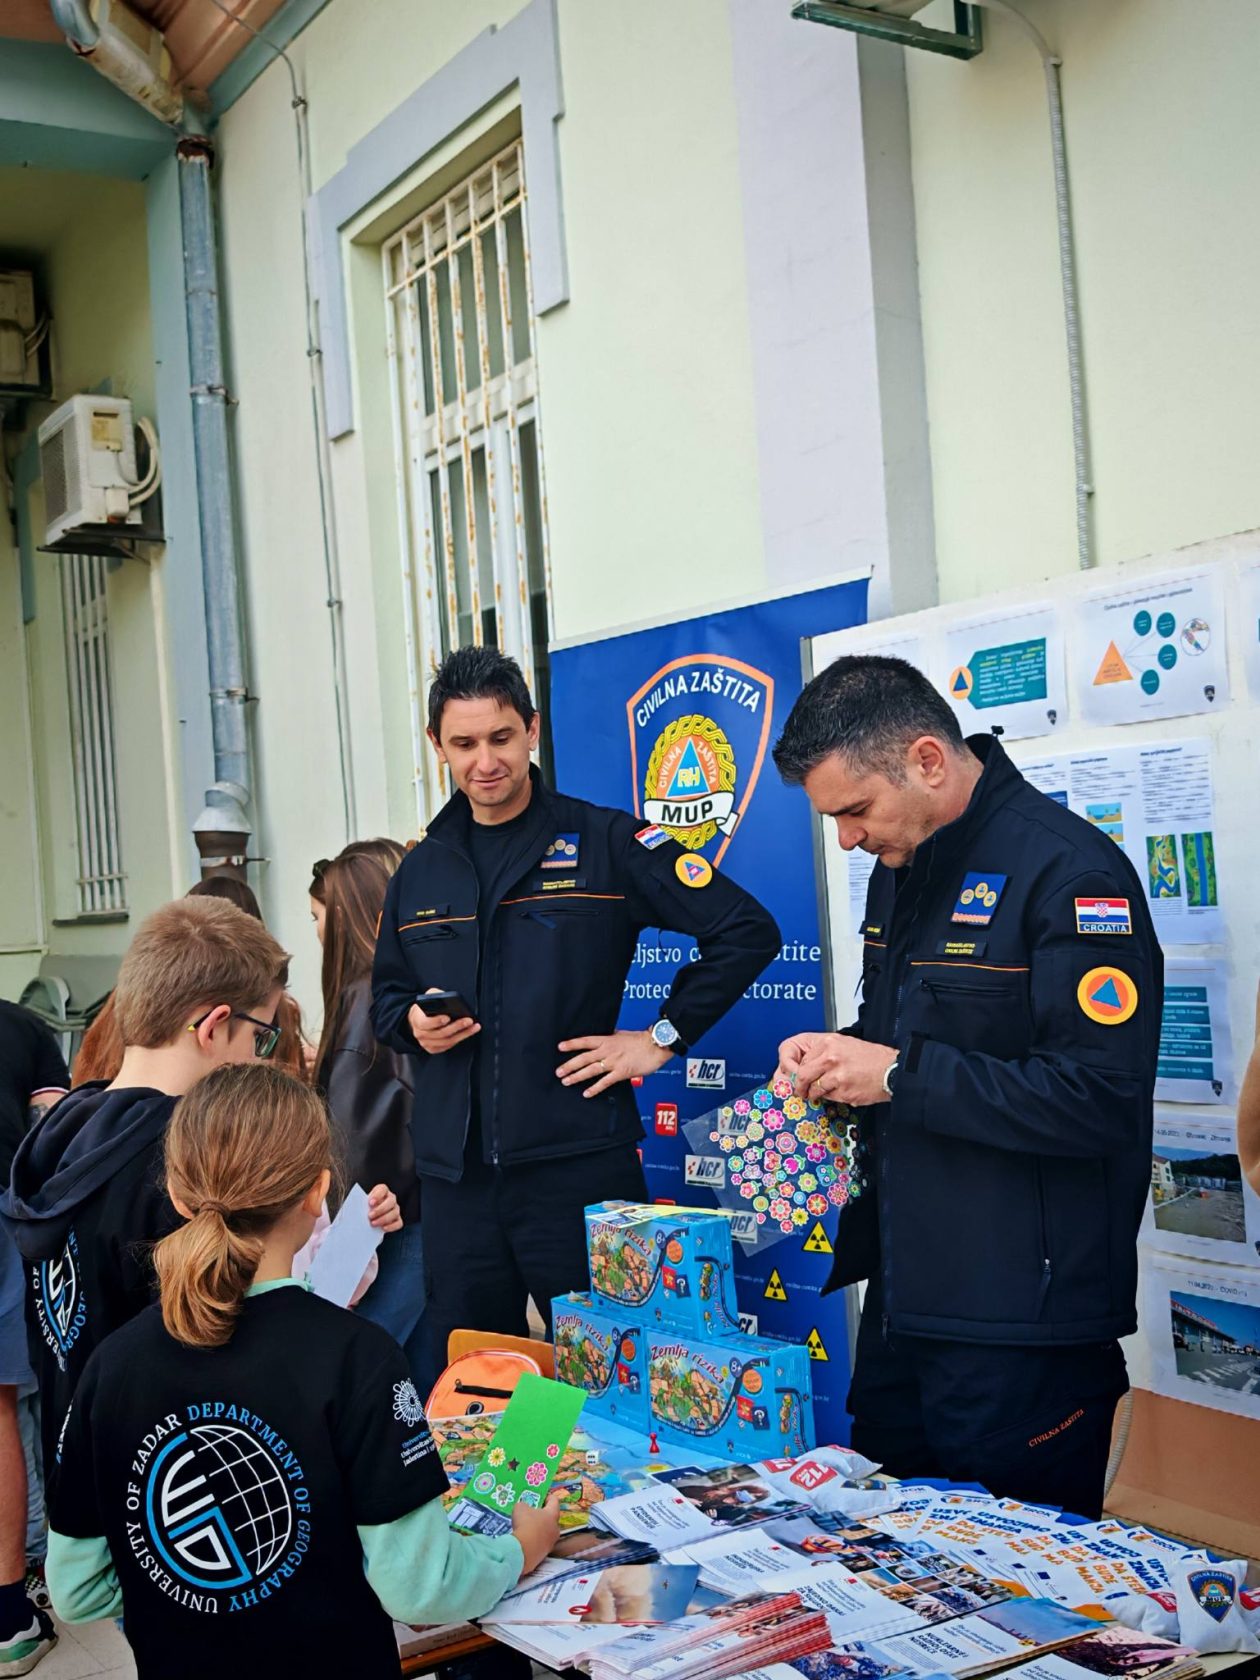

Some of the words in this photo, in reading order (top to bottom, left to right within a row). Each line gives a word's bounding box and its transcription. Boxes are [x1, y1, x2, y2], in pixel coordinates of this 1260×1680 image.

[636, 674, 688, 728] CIVILNA
[690, 668, 762, 713] ZAŠTITA
[660, 746, 682, 788] CIVILNA
[677, 766, 701, 788] RH
[661, 800, 713, 824] MUP
[1083, 924, 1128, 933] CROATIA
[632, 942, 681, 968] ljstvo
[774, 940, 822, 962] tite
[743, 981, 817, 1000] ctorate
[697, 1060, 721, 1080] hcr
[656, 1110, 676, 1126] 112
[624, 1229, 652, 1256] rizika
[656, 1232, 666, 1243] 8+
[651, 1343, 690, 1361] Zemlja
[691, 1353, 724, 1384] rizika
[730, 1360, 743, 1373] 8+
[132, 1413, 183, 1475] ZADAR
[187, 1402, 304, 1481] DEPARTMENT
[1028, 1427, 1060, 1447] CIVILNA
[800, 1462, 829, 1488] 112
[126, 1481, 141, 1511] OF
[293, 1487, 311, 1513] OF
[966, 1515, 1022, 1534] ZNANJA
[977, 1510, 1051, 1533] USVOJIMO
[126, 1522, 218, 1614] UNIVERSITY
[229, 1520, 311, 1613] GEOGRAPHY
